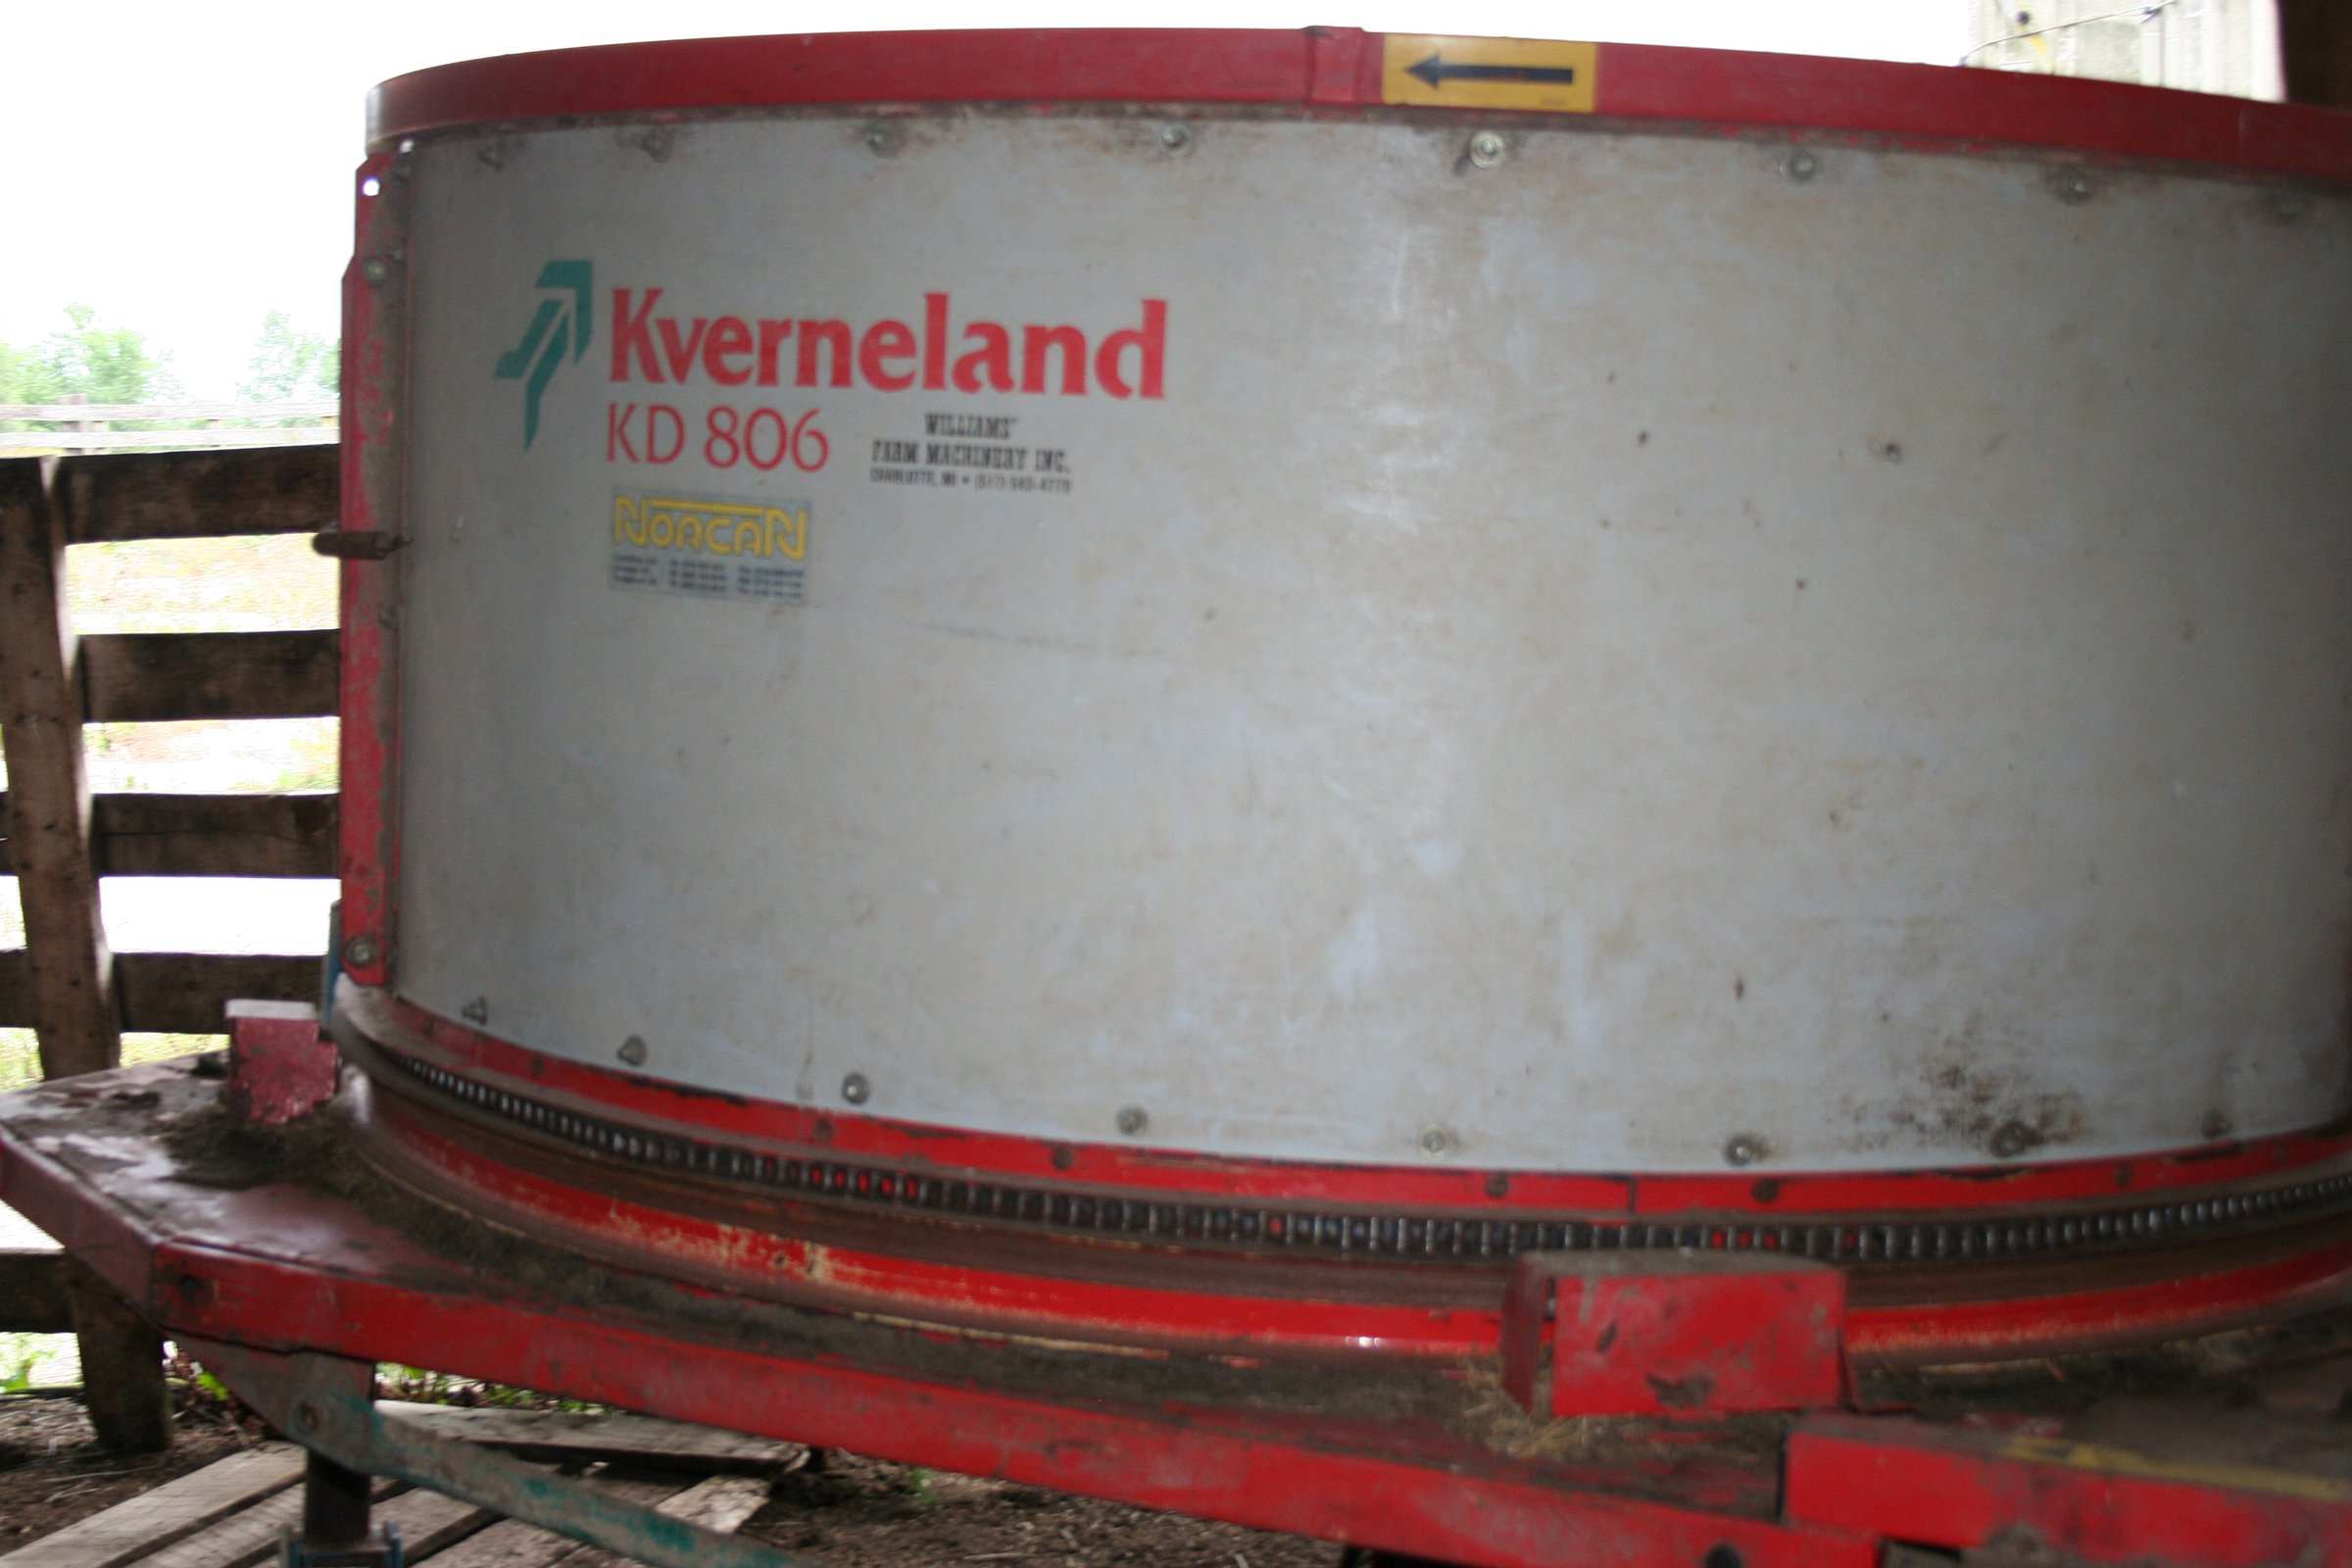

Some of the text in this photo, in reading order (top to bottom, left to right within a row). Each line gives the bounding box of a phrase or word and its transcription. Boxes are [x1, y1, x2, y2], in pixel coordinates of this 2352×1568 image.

[610, 288, 1167, 399] Kverneland
[607, 402, 829, 471] KD 806
[871, 439, 919, 464] FARM
[925, 443, 1028, 470] MACHINERY
